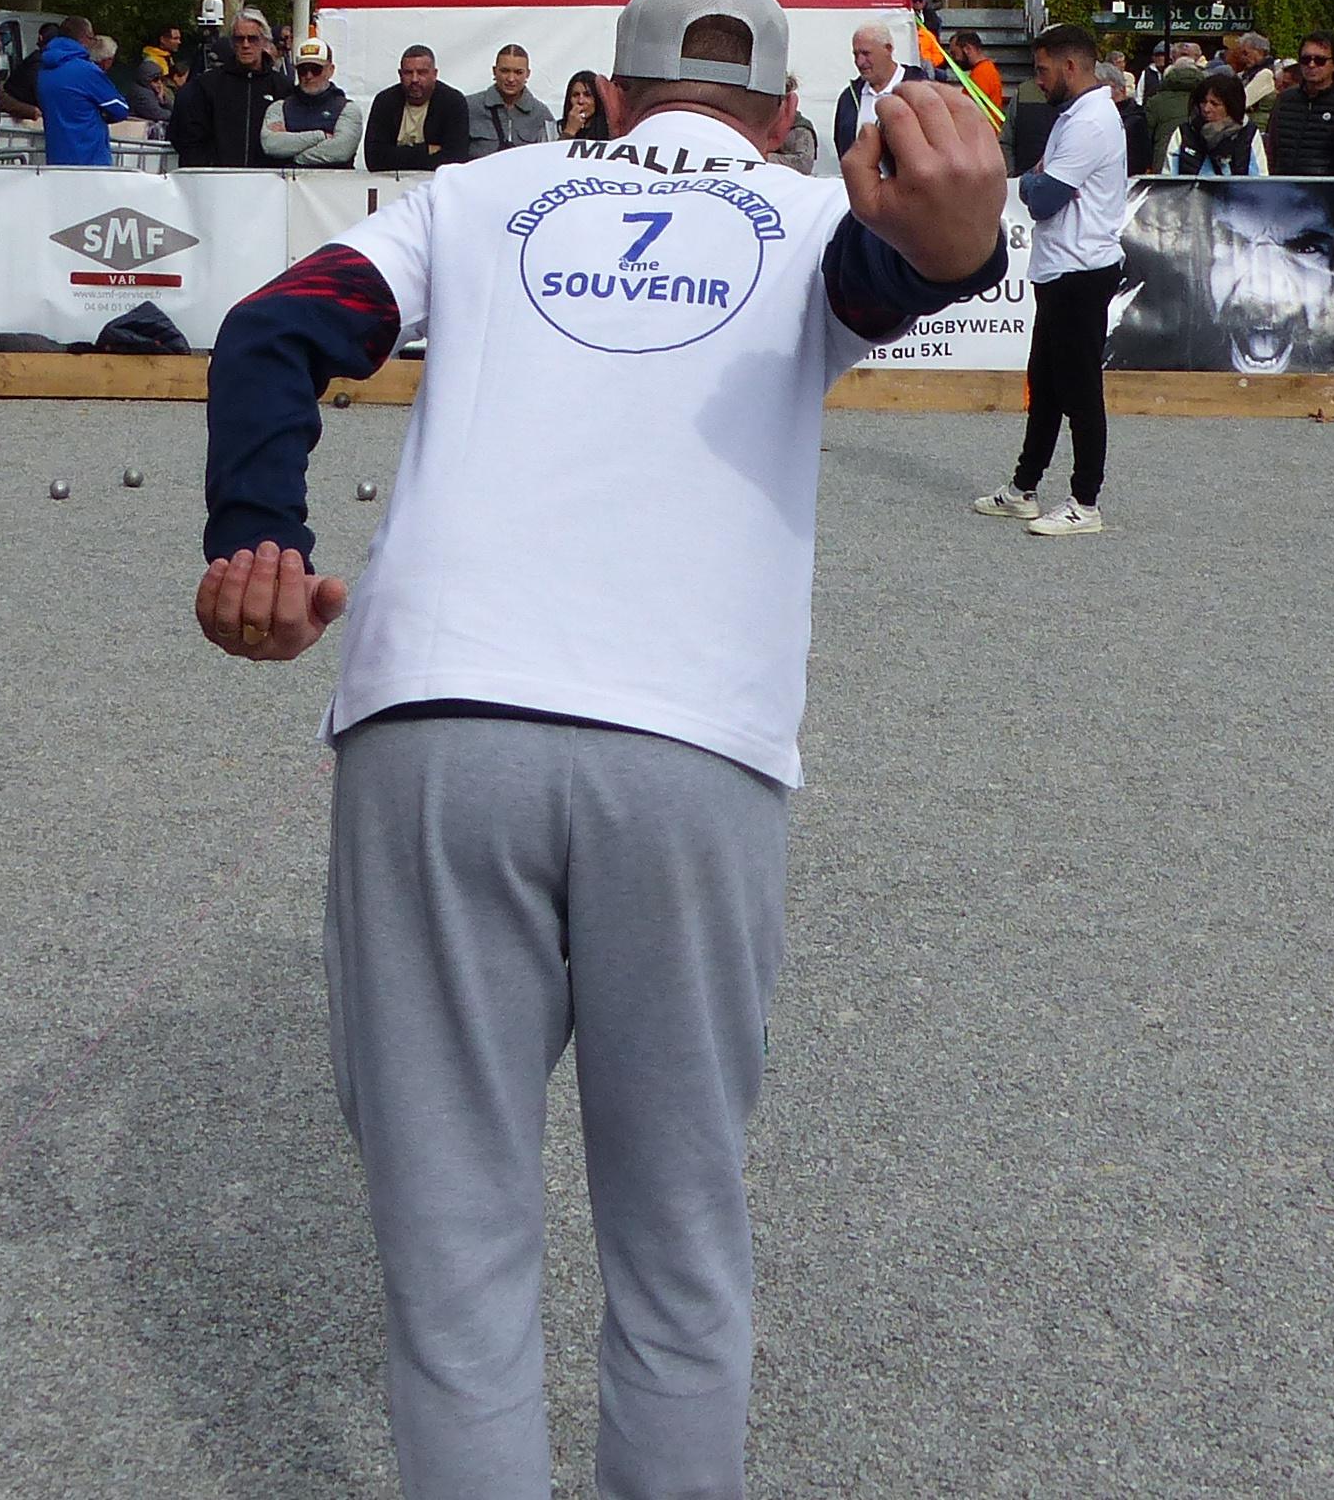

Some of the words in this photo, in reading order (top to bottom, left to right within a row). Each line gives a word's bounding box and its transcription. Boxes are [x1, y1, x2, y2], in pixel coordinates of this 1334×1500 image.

[1127, 4, 1154, 20] LE
[1134, 21, 1154, 30] BAR
[1198, 21, 1223, 30] LOTO
[567, 141, 766, 174] MALLET
[649, 179, 786, 240] ALBERTINI
[83, 217, 164, 260] SMF
[623, 212, 673, 262] 7
[109, 275, 136, 285] VAR
[73, 289, 162, 300] www.smf-services.fr
[542, 272, 730, 308] SOUVENIR
[84, 302, 95, 311] 04
[97, 302, 109, 311] 94
[111, 302, 121, 311] 01
[891, 347, 915, 360] au
[921, 342, 953, 358] 5XL
